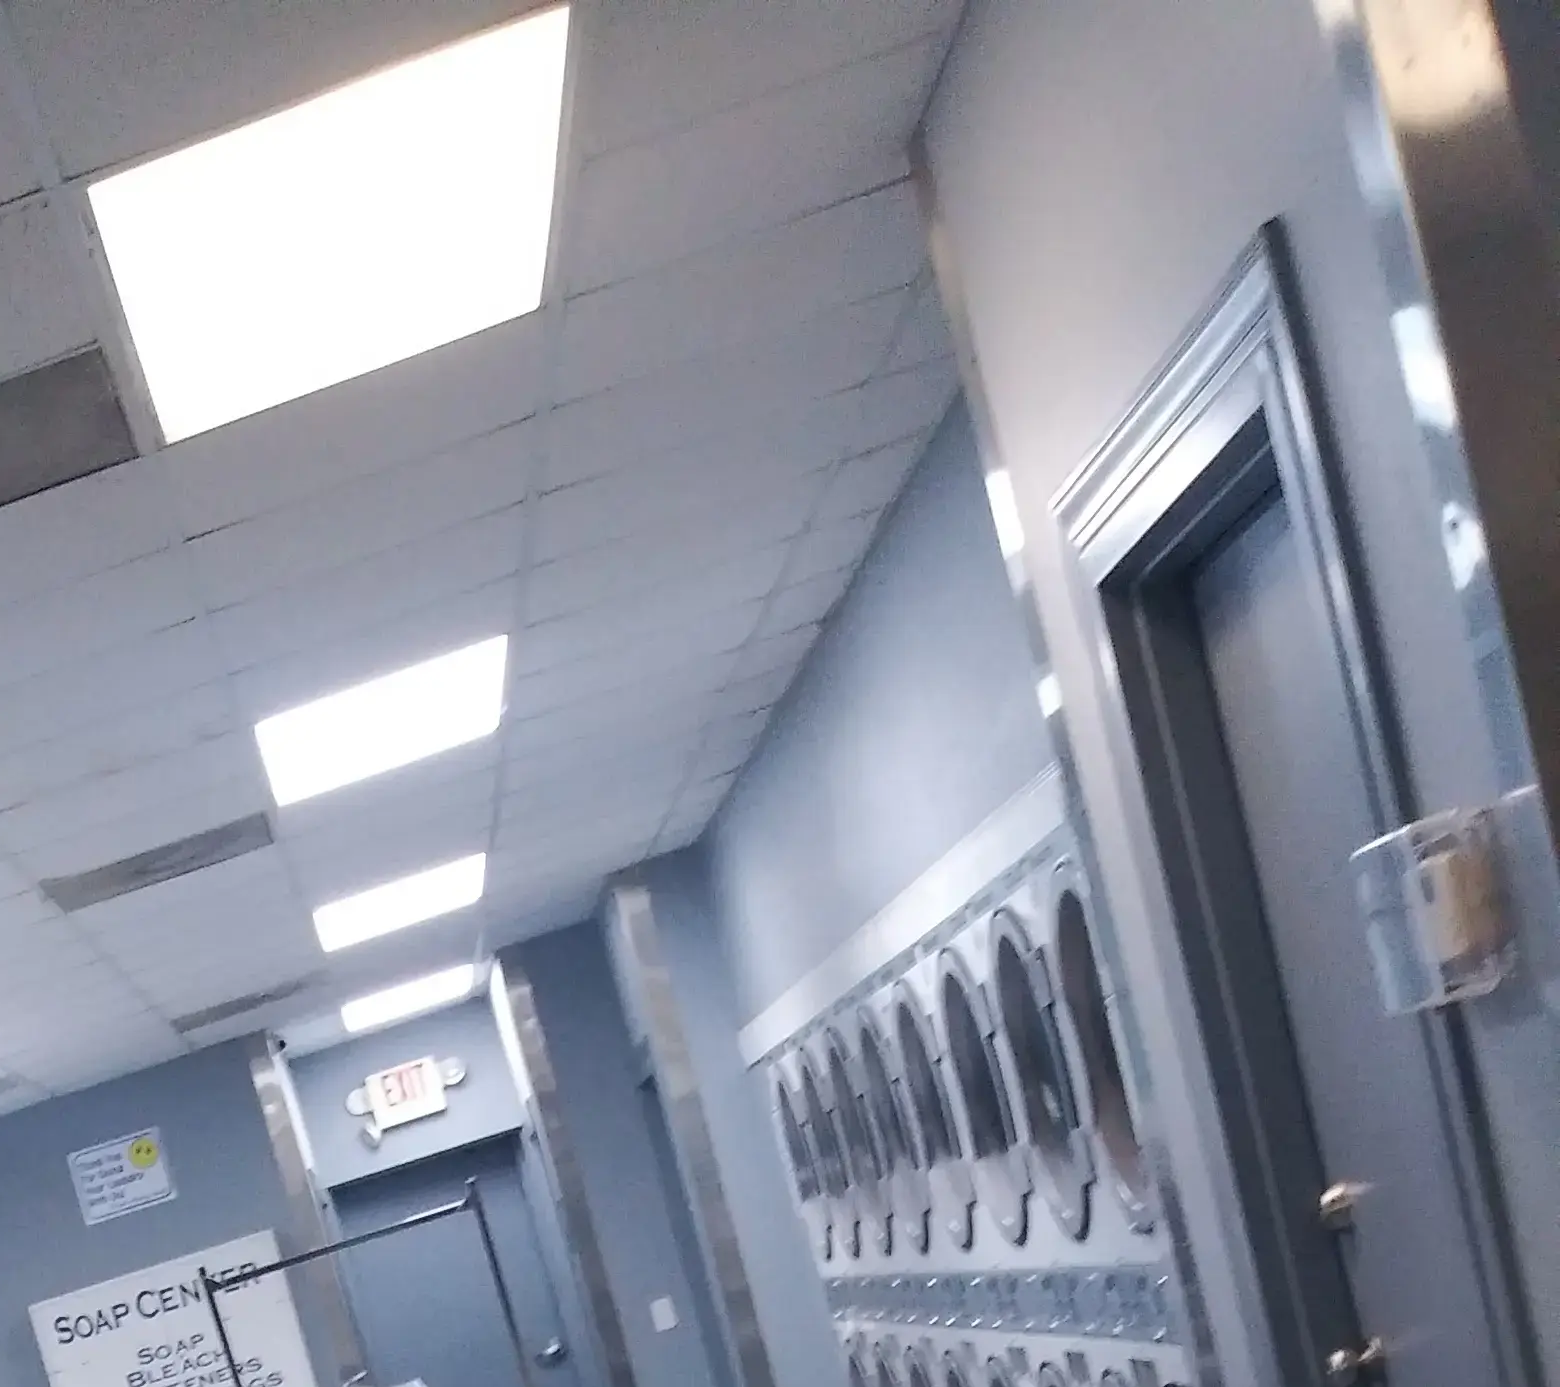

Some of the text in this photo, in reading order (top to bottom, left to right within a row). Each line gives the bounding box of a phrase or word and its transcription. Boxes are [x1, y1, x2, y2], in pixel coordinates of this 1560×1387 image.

[381, 1063, 427, 1108] EXIT
[54, 1302, 130, 1345] SOAP
[138, 1333, 205, 1366] SOAP
